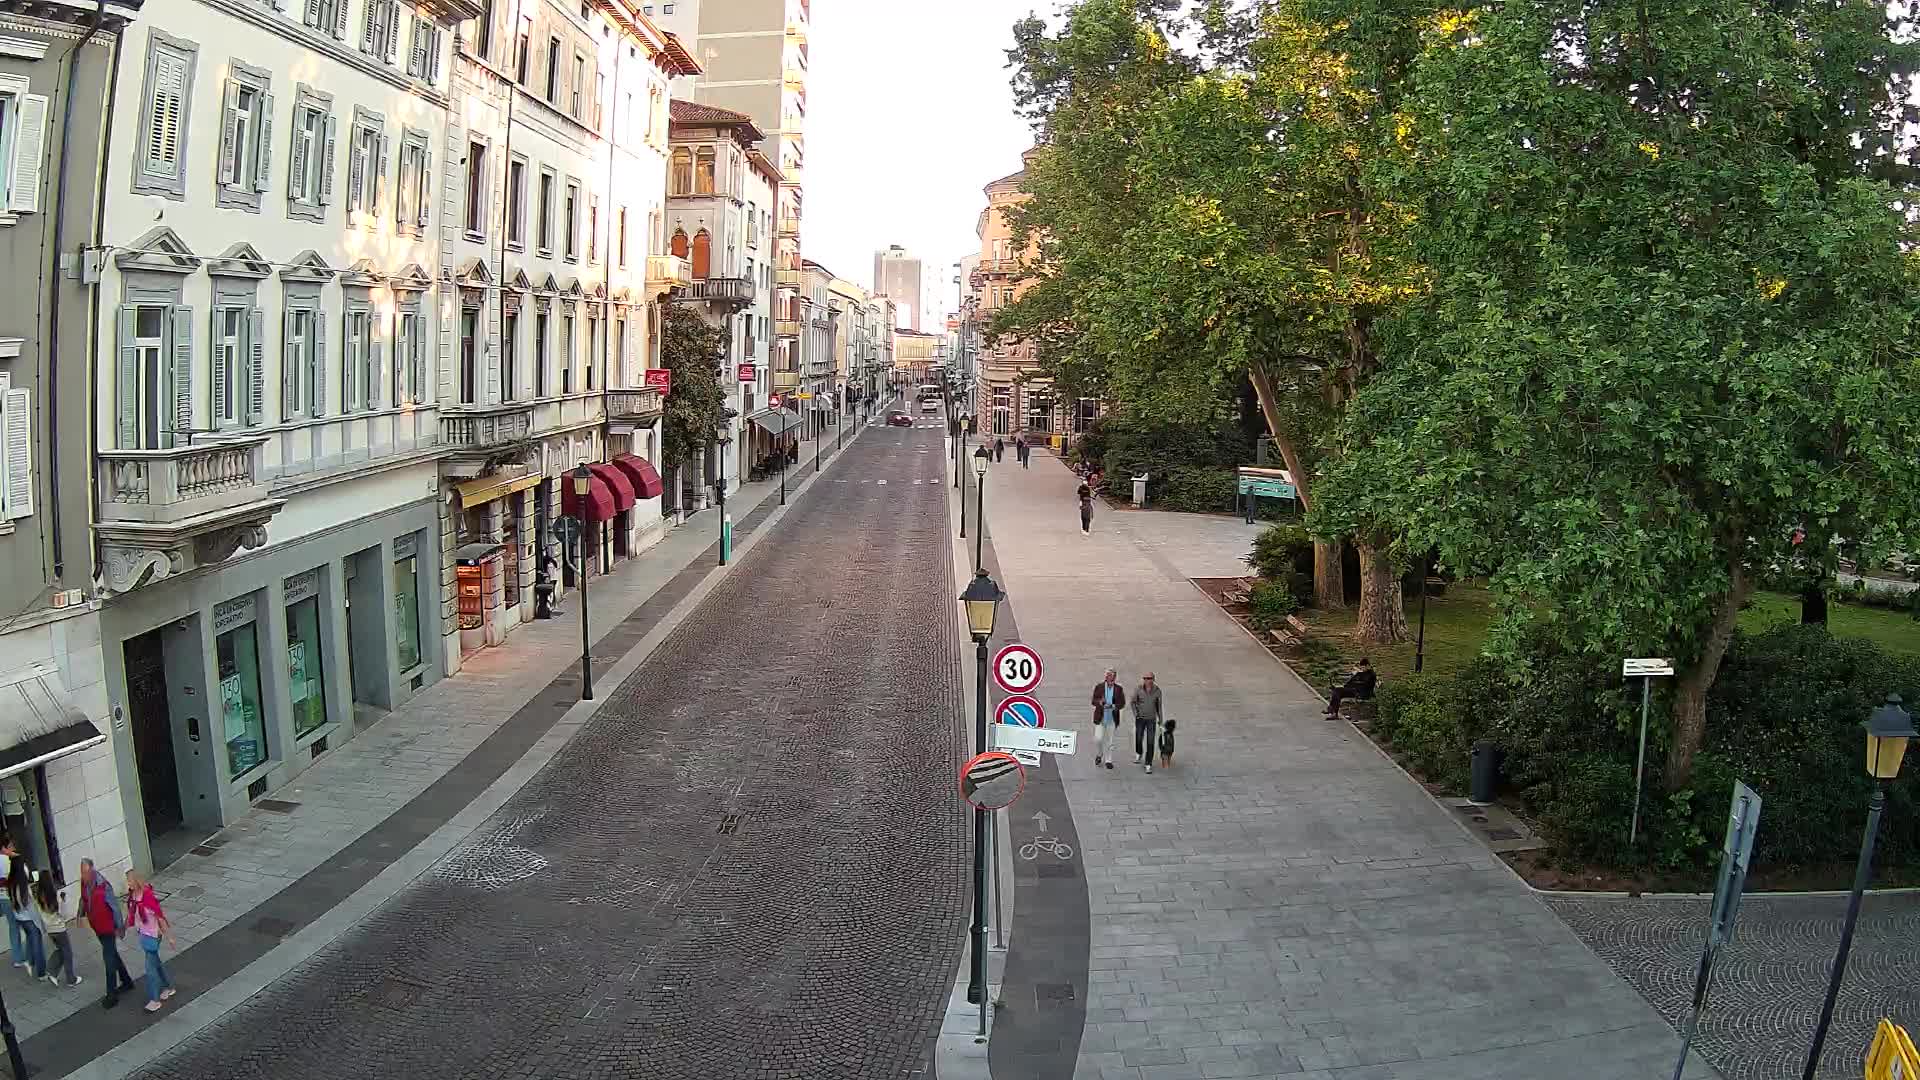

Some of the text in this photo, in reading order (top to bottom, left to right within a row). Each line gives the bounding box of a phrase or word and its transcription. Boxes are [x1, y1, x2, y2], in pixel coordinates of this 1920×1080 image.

[1004, 658, 1032, 680] 30
[221, 678, 240, 700] 130
[1037, 738, 1069, 749] Dante
